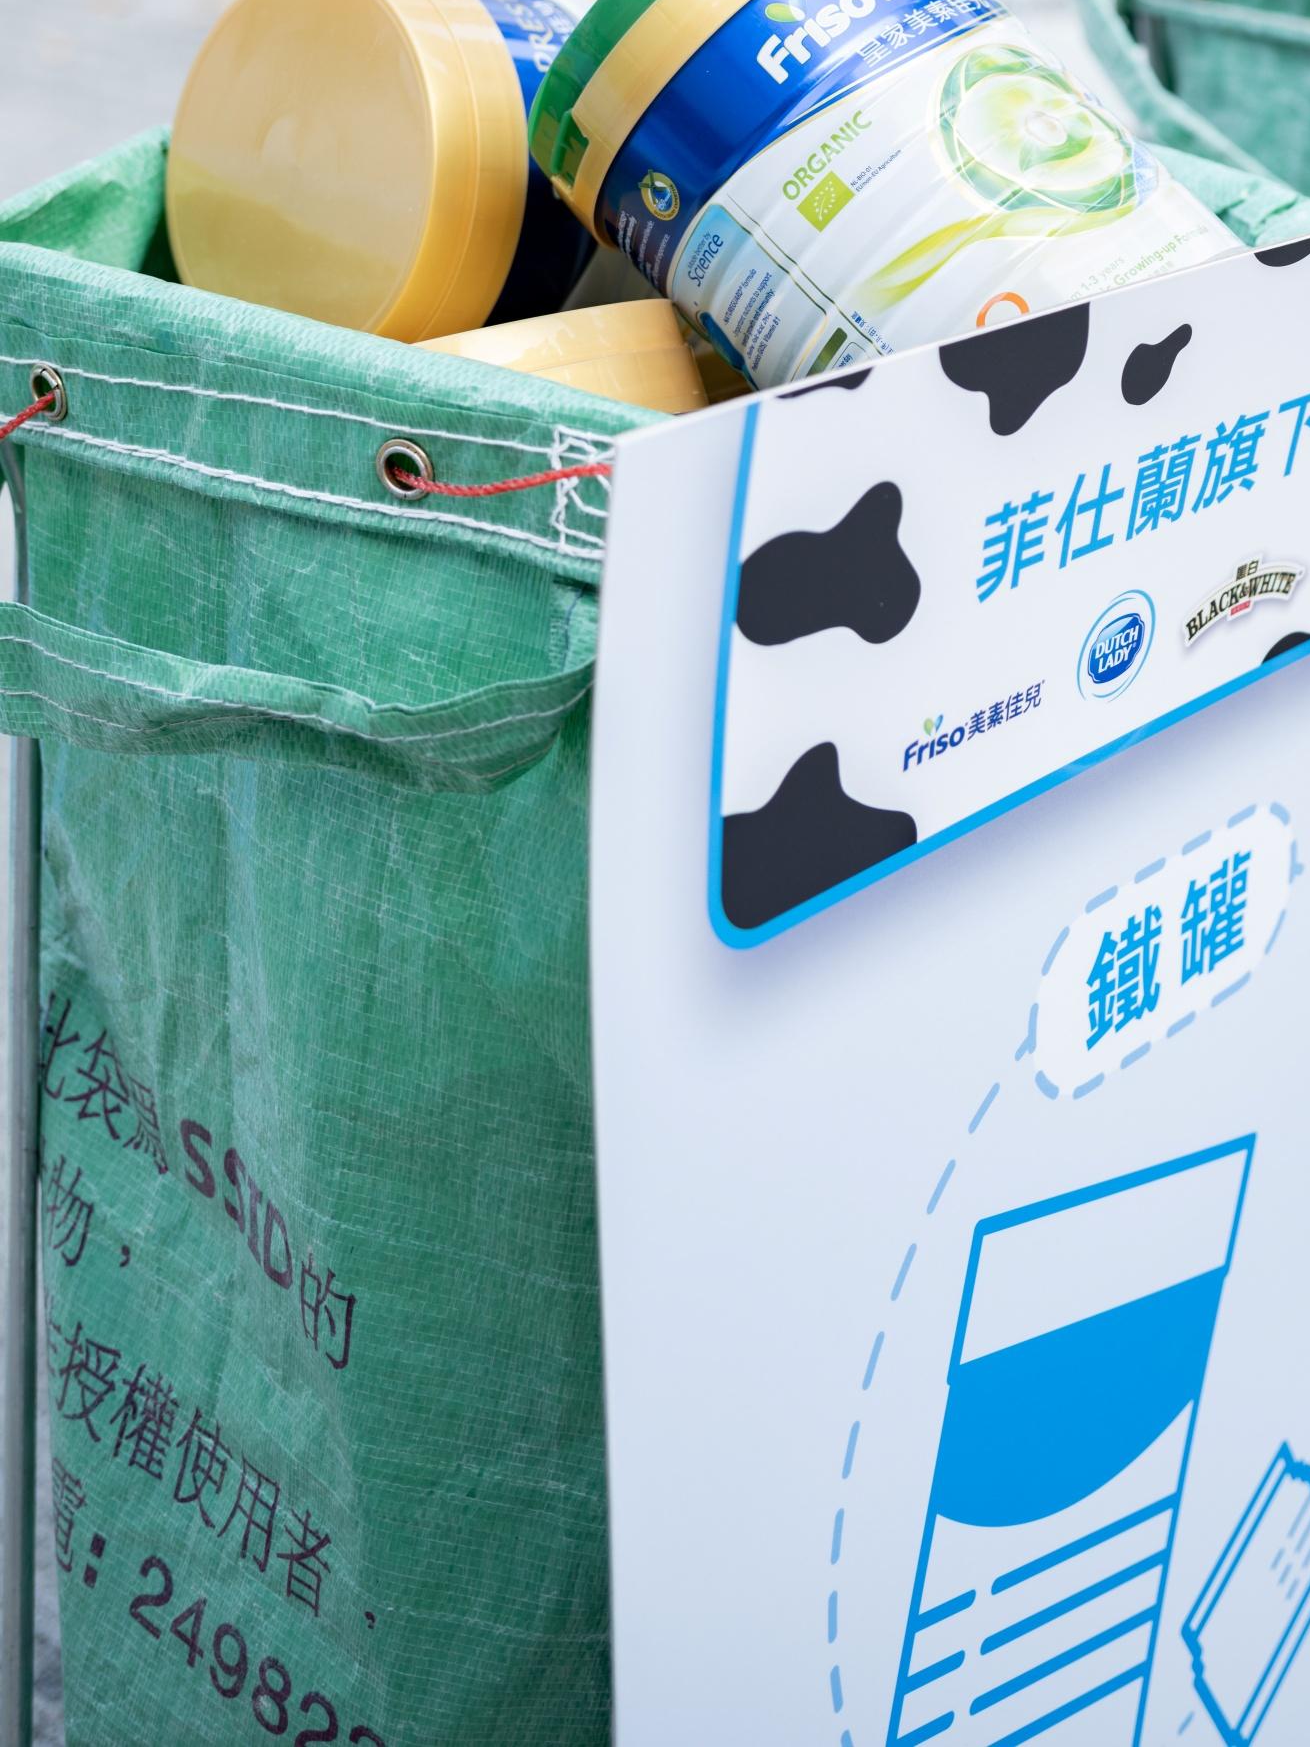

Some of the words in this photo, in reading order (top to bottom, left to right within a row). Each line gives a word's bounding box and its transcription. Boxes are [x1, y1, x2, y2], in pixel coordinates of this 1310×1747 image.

[783, 111, 872, 200] ORGANIC
[688, 234, 723, 287] Science
[1114, 240, 1178, 286] Growing-up
[1095, 625, 1139, 660] DUTCH
[1098, 645, 1133, 674] LADY
[903, 726, 966, 772] Friso
[967, 683, 1042, 741] 美素佳兒
[1086, 850, 1252, 1052] 鐵罐
